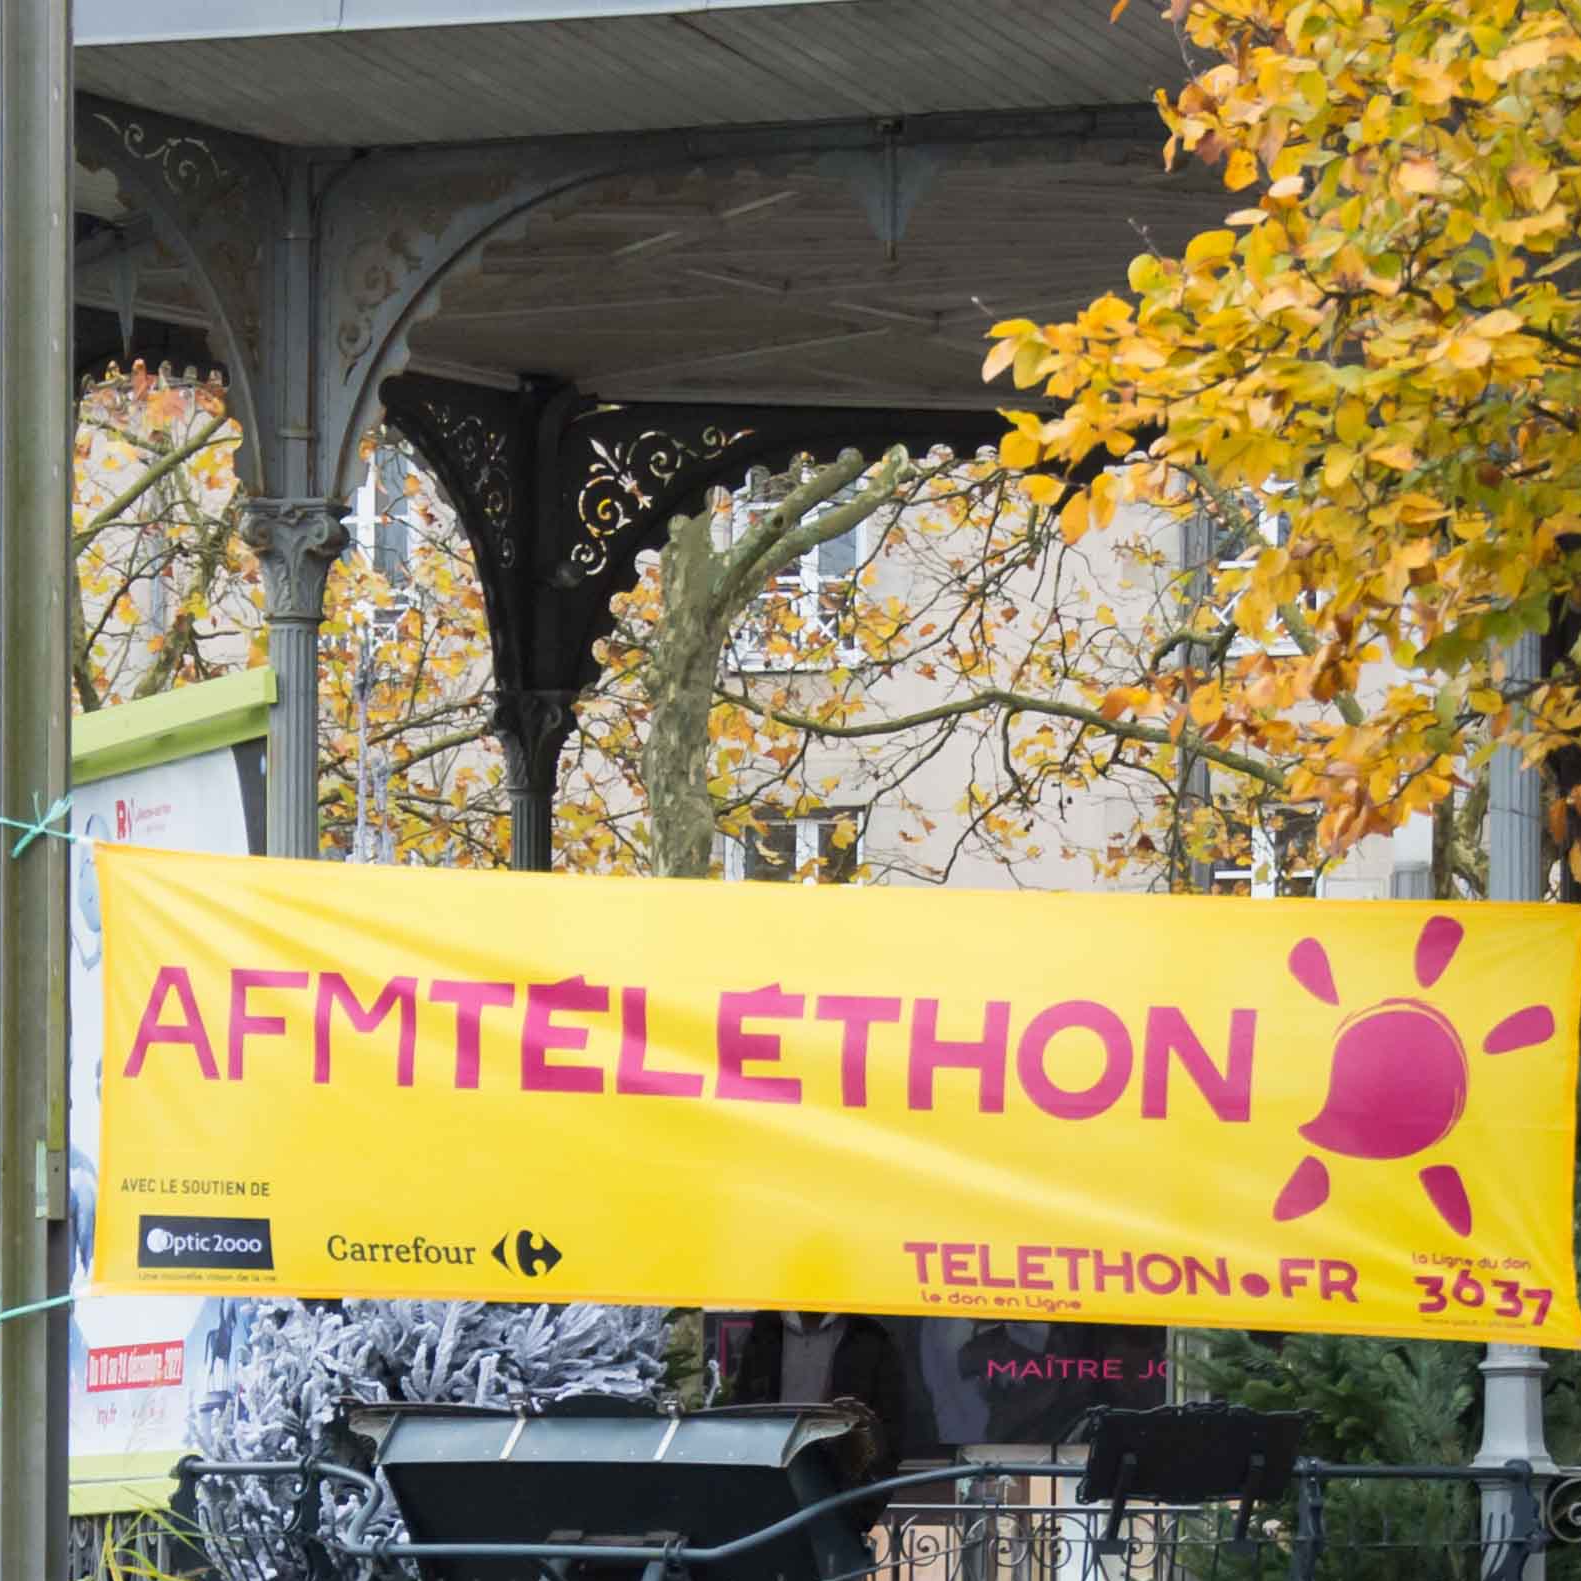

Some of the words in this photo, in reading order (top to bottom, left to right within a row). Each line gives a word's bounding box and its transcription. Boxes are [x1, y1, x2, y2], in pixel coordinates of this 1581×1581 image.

[121, 1178, 156, 1193] AVEC
[161, 1179, 178, 1194] LE
[182, 1180, 245, 1196] SOUTIEN
[250, 1182, 270, 1197] DE
[147, 1228, 210, 1256] Optic
[327, 1234, 476, 1265] Carrefour
[1478, 1257, 1498, 1270] du
[1503, 1257, 1532, 1272] don
[949, 1292, 988, 1306] don
[994, 1296, 1020, 1307] en
[1414, 1269, 1553, 1326] 3637
